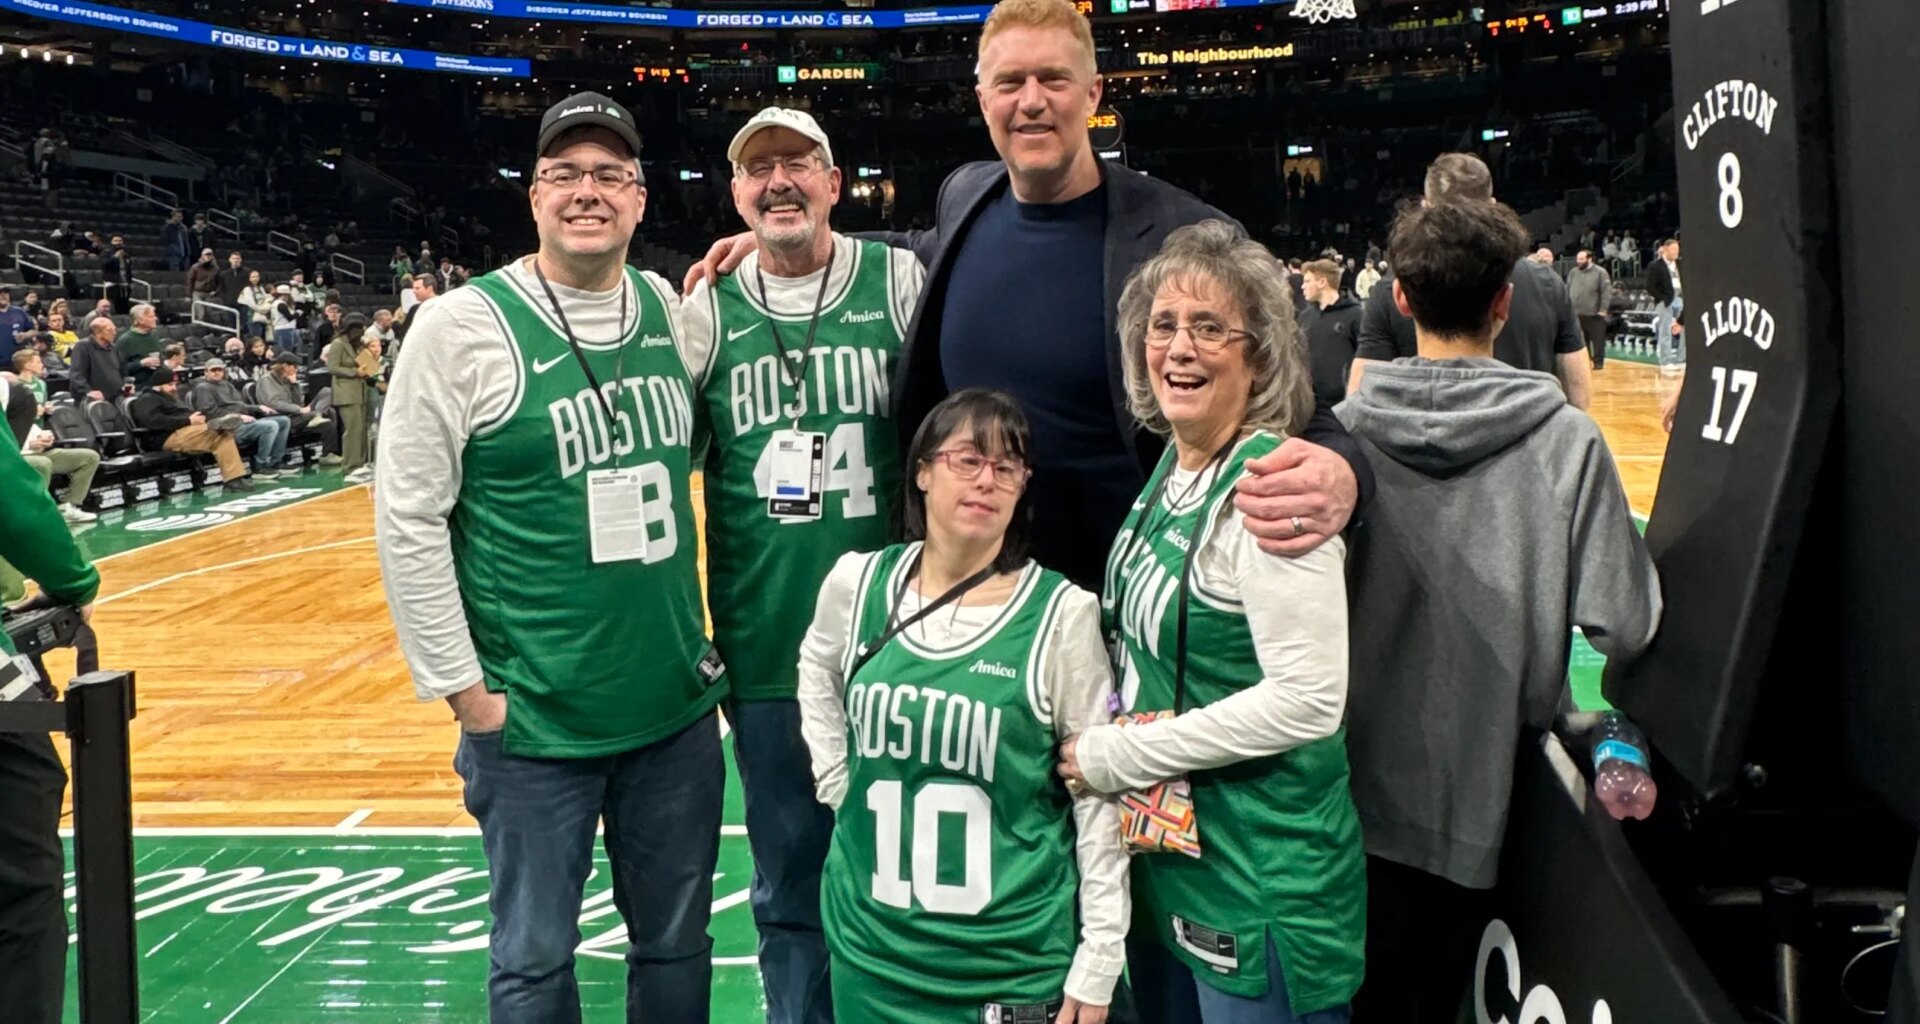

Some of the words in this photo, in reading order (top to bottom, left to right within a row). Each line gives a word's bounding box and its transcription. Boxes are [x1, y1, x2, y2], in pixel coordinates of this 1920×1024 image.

[526, 6, 569, 14] DISCOVER
[628, 12, 668, 20] BOURBON
[697, 14, 764, 26] FORGED
[780, 14, 824, 26] LAND
[826, 12, 839, 26] &
[842, 14, 874, 26] SEA
[1583, 6, 1607, 18] Bank
[1615, 2, 1638, 14] 2:39
[1640, 0, 1658, 10] PM
[132, 18, 179, 32] BOURBON
[211, 30, 280, 52] FORGED
[284, 43, 296, 52] BY
[300, 42, 349, 58] LAND
[352, 46, 366, 61] &
[368, 49, 404, 64] SEA
[1137, 52, 1168, 65] The
[1172, 42, 1293, 64] Neighbourhood
[798, 68, 864, 80] GARDEN
[1682, 80, 1778, 150] CLIFTON
[1717, 152, 1744, 228] 8
[840, 310, 884, 324] Amica
[1701, 297, 1776, 350] LLOYD
[641, 334, 672, 348] Amica
[730, 346, 890, 437] BOSTON
[1702, 366, 1758, 444] 17
[549, 375, 692, 480] BOSTON
[752, 422, 877, 518] 4
[969, 659, 1017, 678] Amica
[850, 682, 1002, 784] BOSTON
[866, 780, 992, 915] 10
